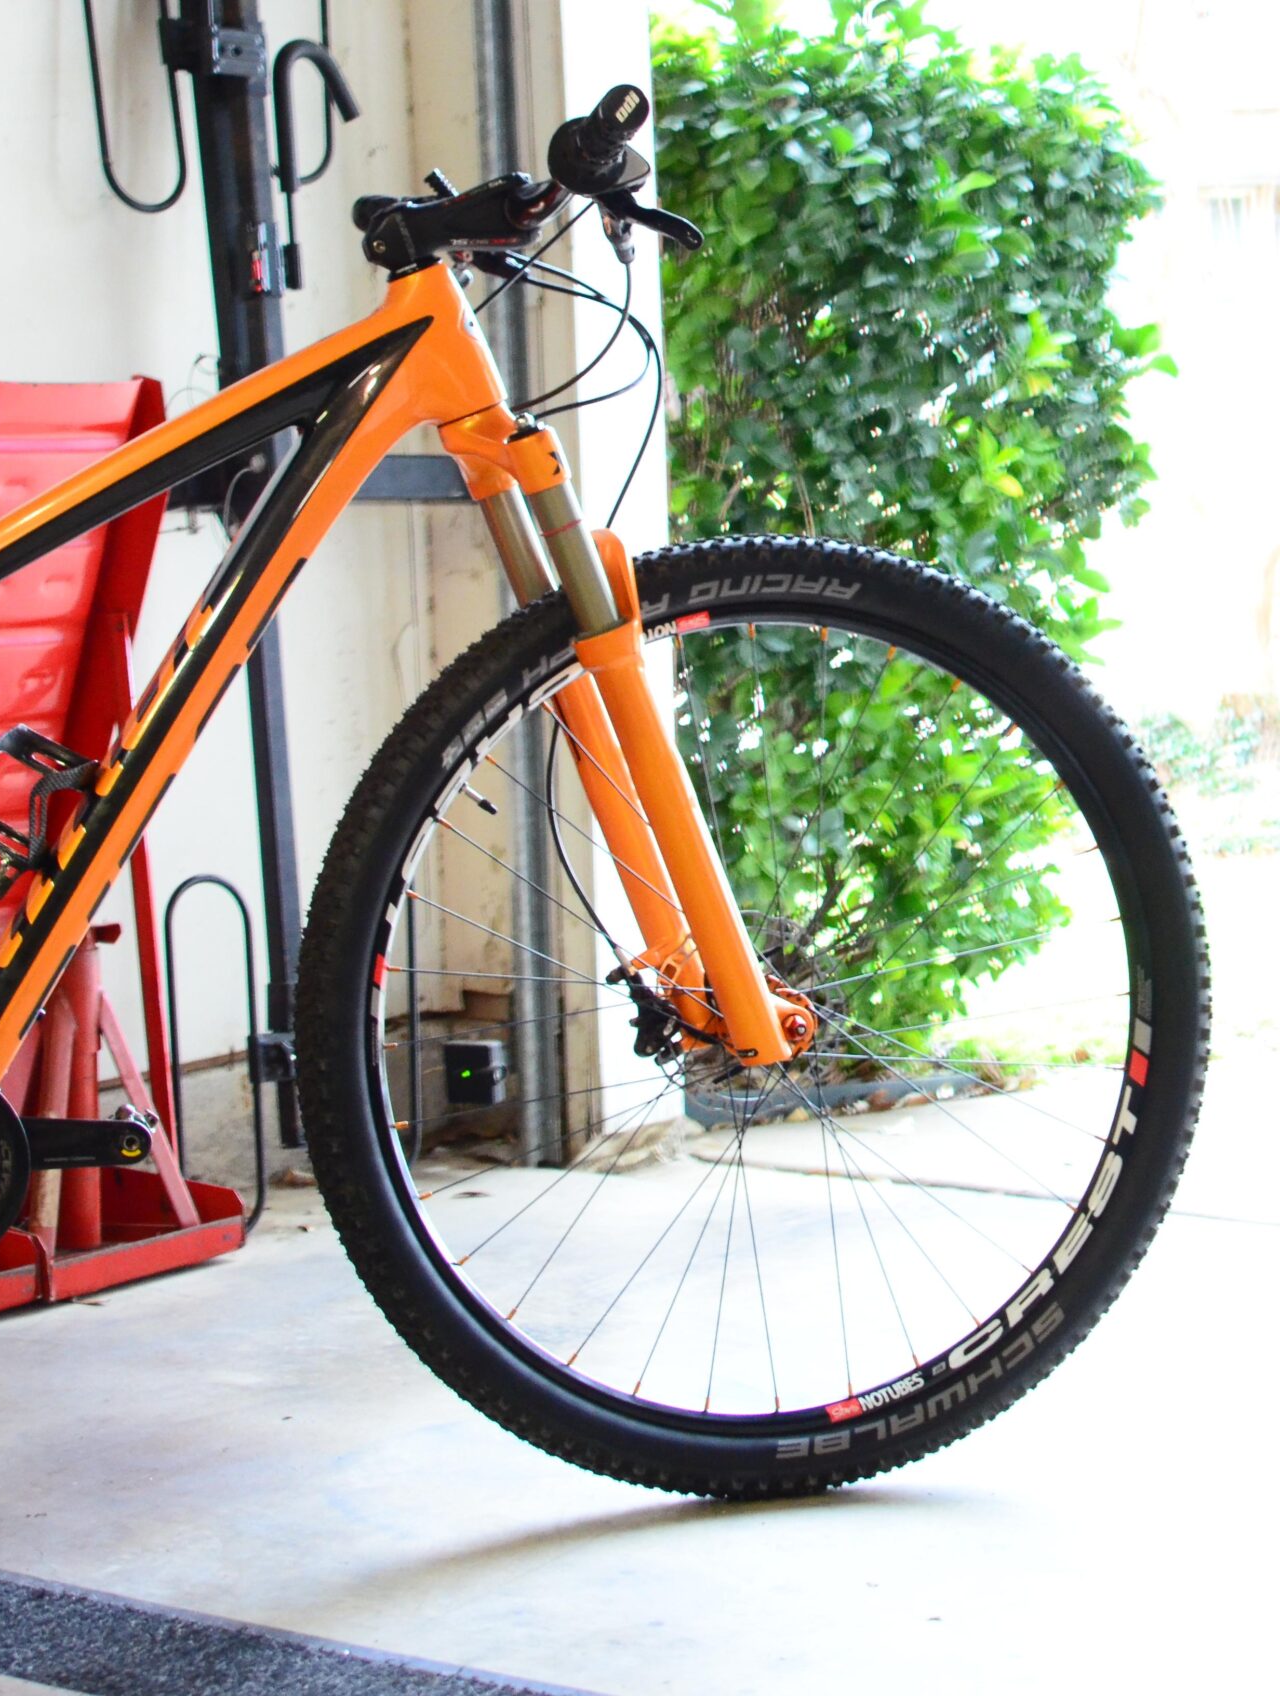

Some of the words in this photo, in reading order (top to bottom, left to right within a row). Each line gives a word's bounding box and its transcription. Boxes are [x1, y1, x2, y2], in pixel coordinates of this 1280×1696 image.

[688, 573, 862, 602] RACING
[858, 1372, 925, 1412] NOTUBES
[948, 1085, 1138, 1369] CREST
[775, 1301, 1065, 1459] SCHWALBE
